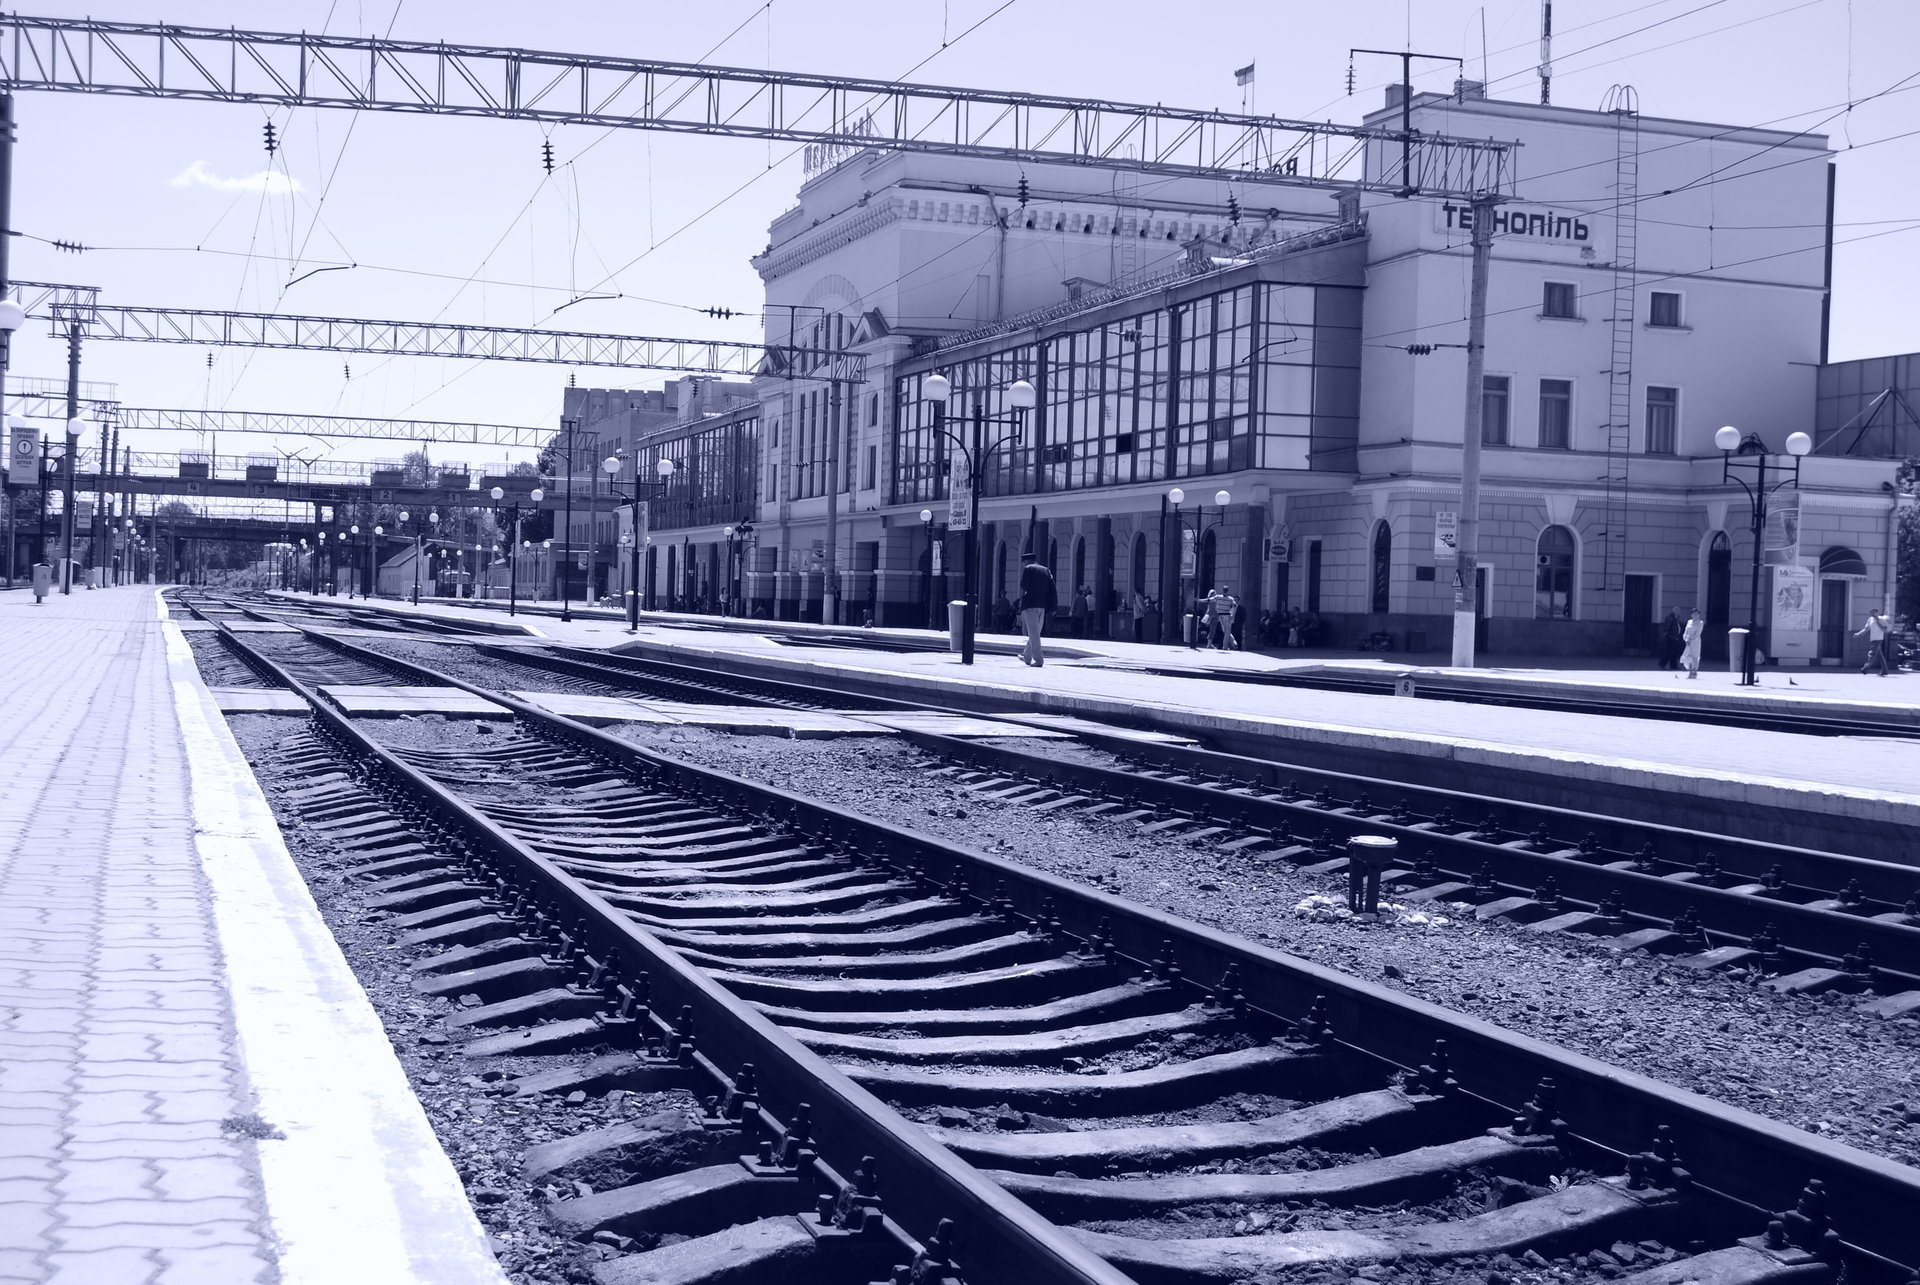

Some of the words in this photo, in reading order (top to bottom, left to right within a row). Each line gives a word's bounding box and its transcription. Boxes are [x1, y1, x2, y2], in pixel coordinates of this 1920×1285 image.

[1442, 204, 1589, 241] ТЕНОПІЛЬ
[259, 485, 265, 493] 3
[383, 491, 389, 499] 2
[1404, 681, 1410, 692] 6
